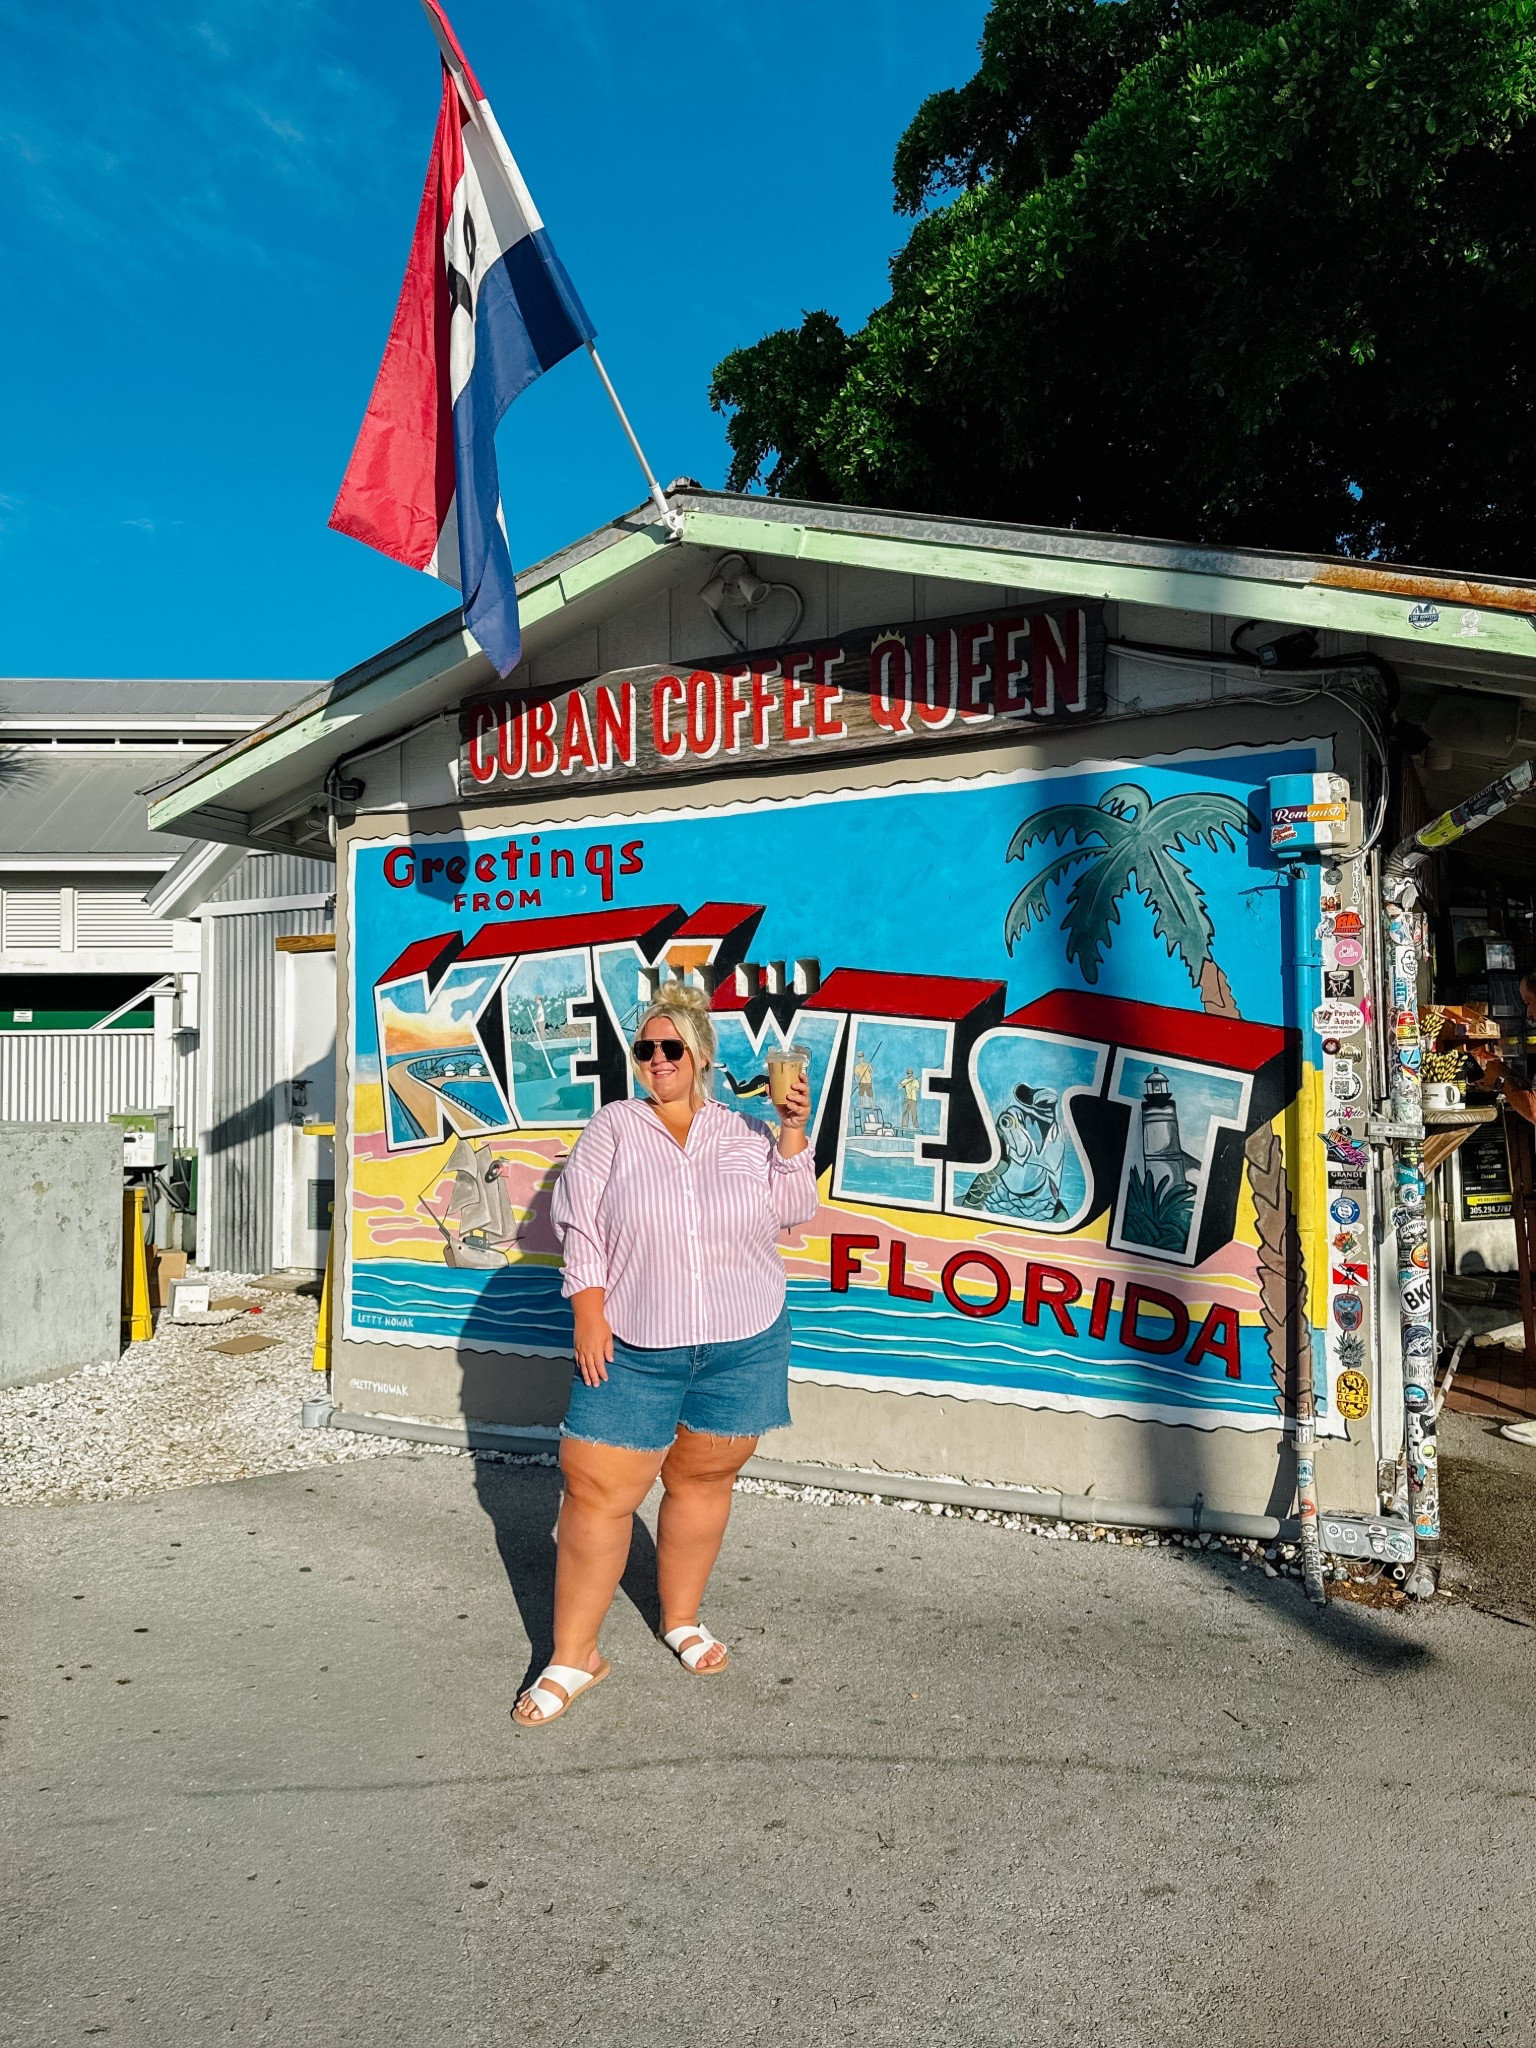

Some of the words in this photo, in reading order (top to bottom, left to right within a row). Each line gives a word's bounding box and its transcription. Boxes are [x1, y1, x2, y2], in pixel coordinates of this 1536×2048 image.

[467, 679, 638, 784] CUBAN
[650, 646, 850, 759] COFFEE
[868, 607, 1089, 735] QUEEN
[1274, 806, 1342, 822] Romanisti
[383, 835, 644, 901] Greetings
[453, 888, 542, 913] FROM
[1333, 1009, 1360, 1017] Psychic
[373, 922, 740, 1153] KEY
[706, 990, 1275, 1268] WEST
[357, 1312, 383, 1326] LETTY
[384, 1315, 415, 1328] NOWAK
[830, 1234, 1241, 1381] FLORIDA
[349, 1377, 409, 1397] @LETTYNOWAK
